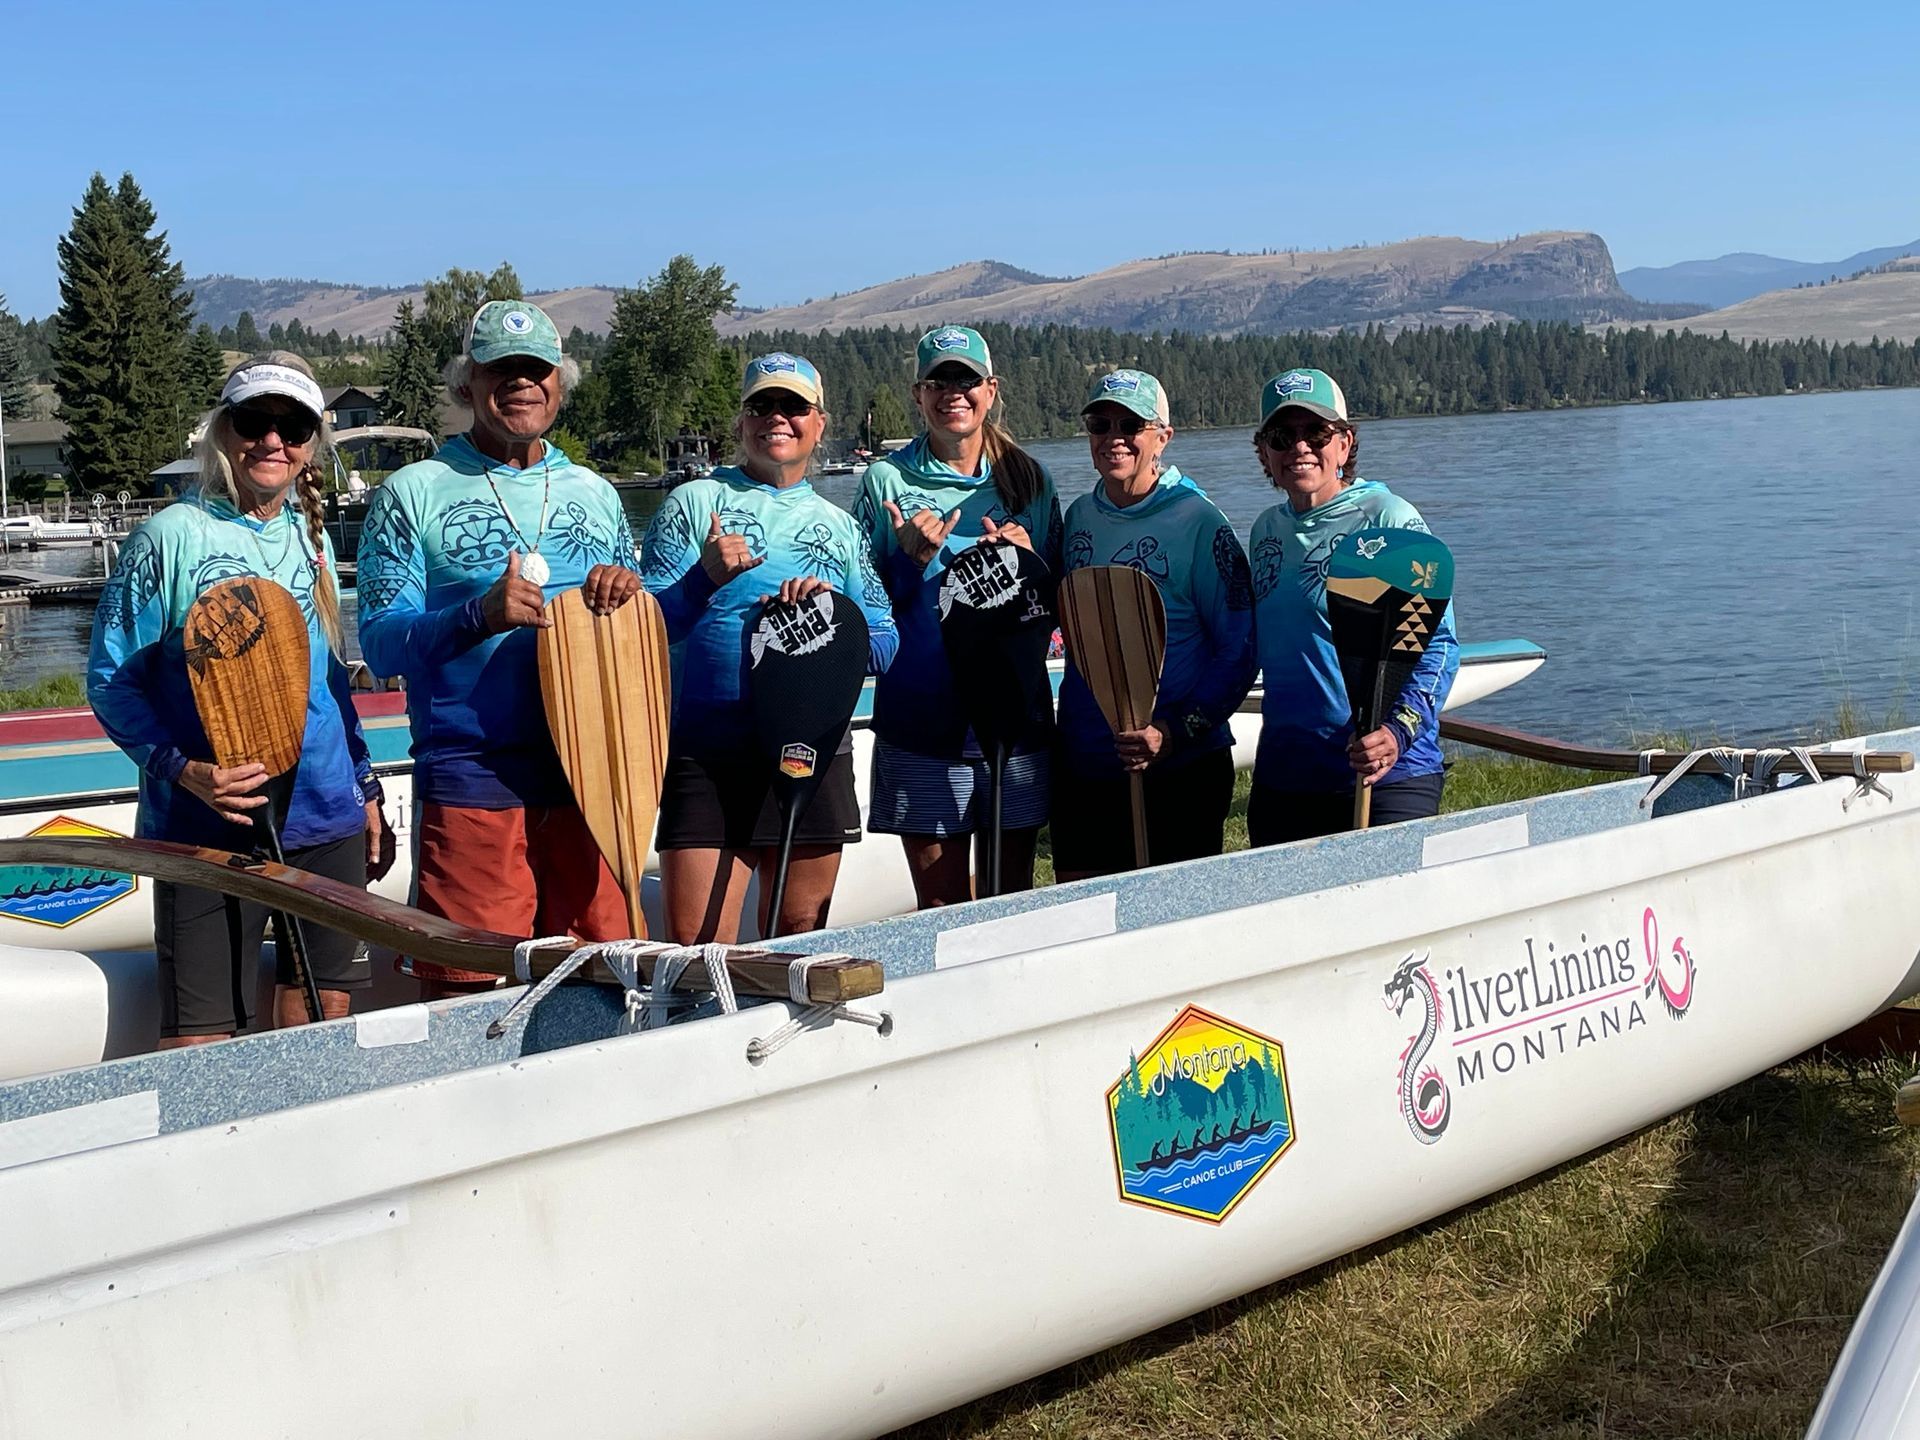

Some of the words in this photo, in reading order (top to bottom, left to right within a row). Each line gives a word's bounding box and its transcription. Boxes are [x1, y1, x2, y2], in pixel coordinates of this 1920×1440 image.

[37, 900, 65, 911] CANOE
[67, 897, 90, 906] CLUB
[1457, 1000, 1647, 1087] MONTANA
[1152, 1041, 1247, 1097] Montana
[1182, 1169, 1217, 1189] CANOE
[1217, 1159, 1244, 1177] CLUB
